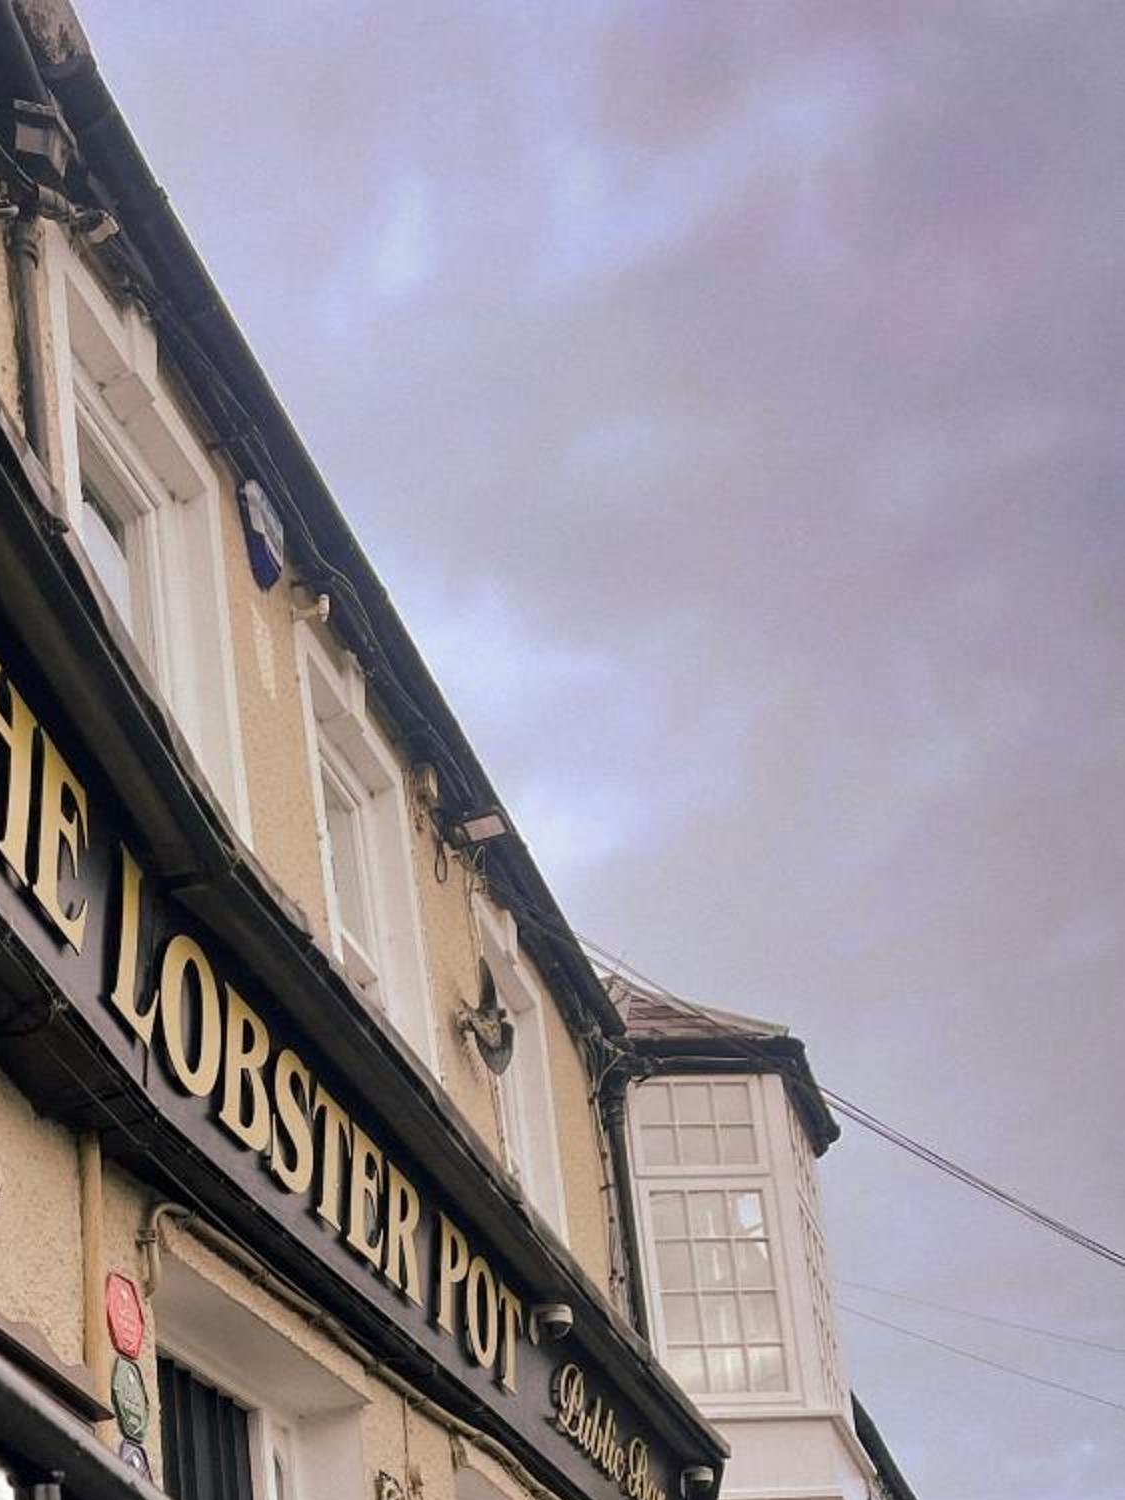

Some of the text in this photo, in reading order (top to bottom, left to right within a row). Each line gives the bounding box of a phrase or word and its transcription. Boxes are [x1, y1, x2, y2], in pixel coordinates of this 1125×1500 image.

[112, 842, 424, 1308] LOBSTER
[436, 1211, 524, 1396] POT
[559, 1363, 625, 1482] Public
